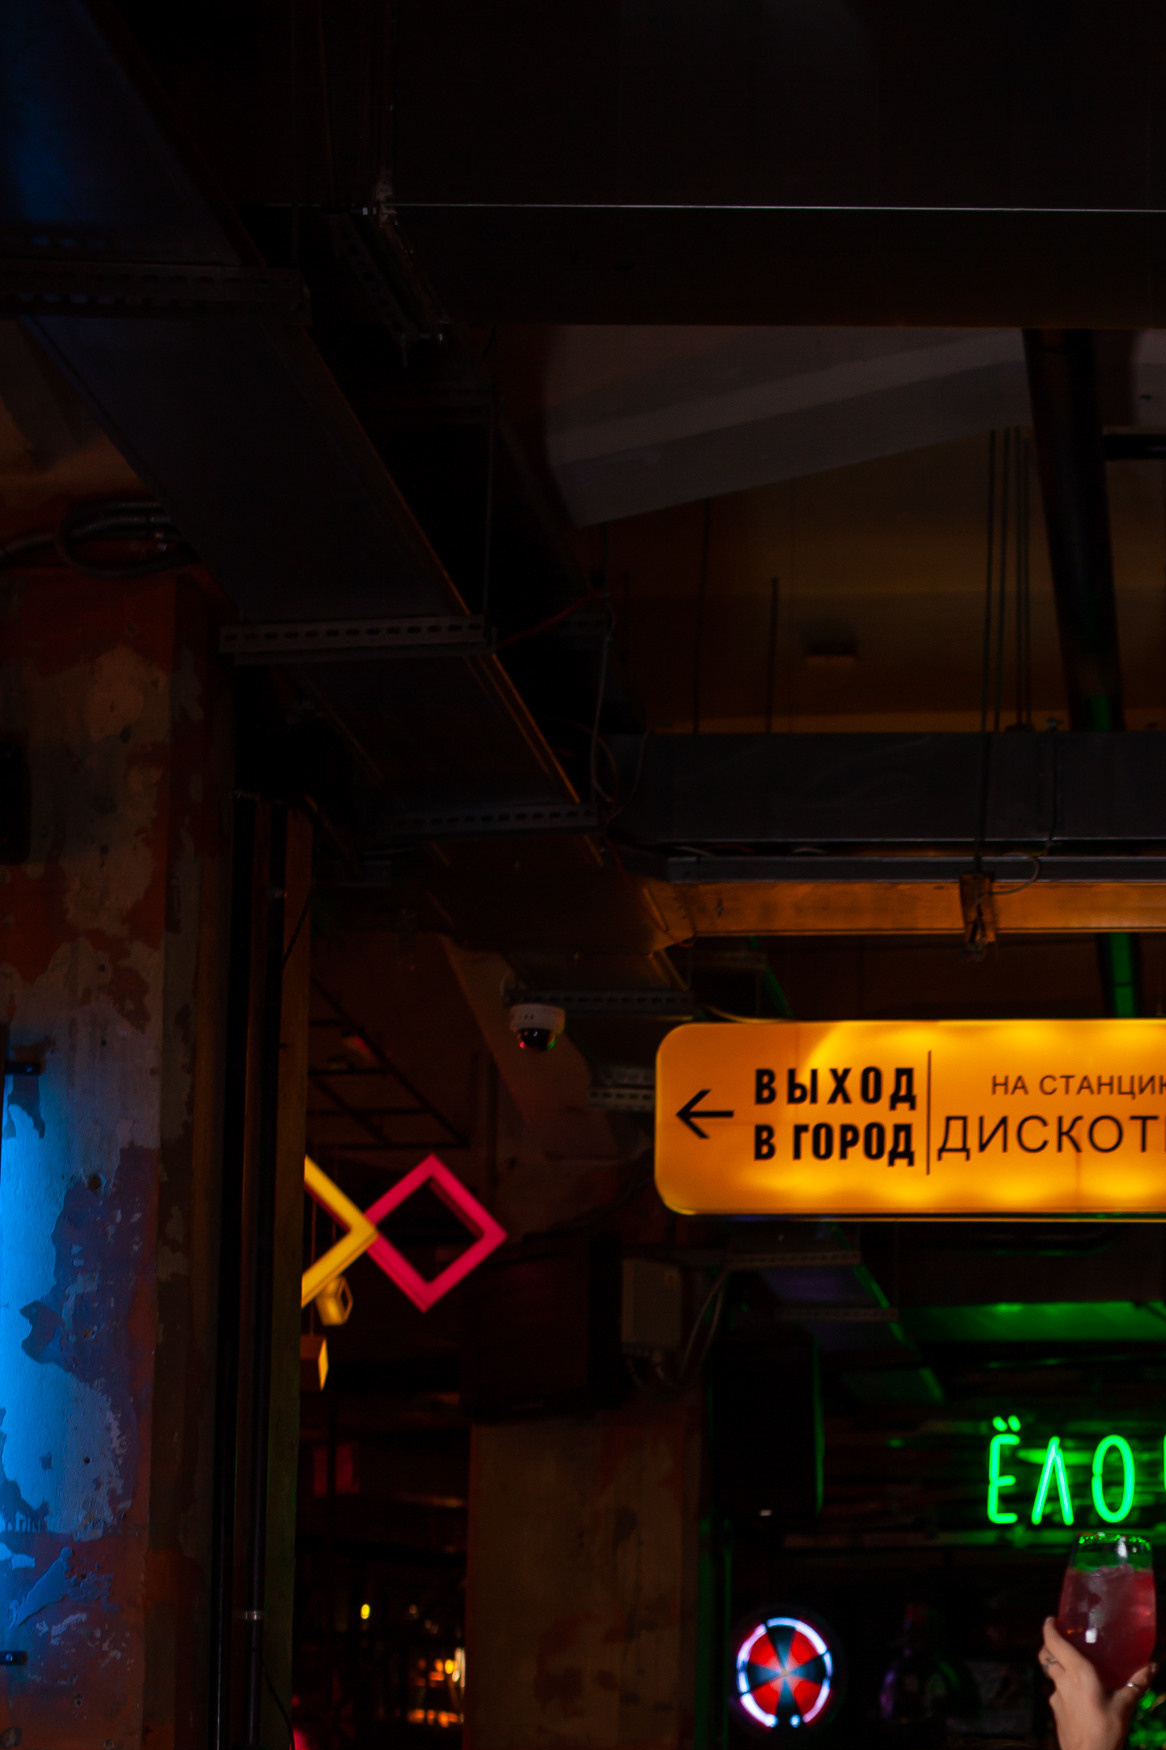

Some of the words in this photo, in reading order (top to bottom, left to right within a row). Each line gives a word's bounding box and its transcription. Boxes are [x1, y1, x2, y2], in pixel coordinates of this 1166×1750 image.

[753, 1066, 917, 1111] ВЫХОД
[990, 1074, 1030, 1096] НА
[753, 1122, 777, 1162] В
[792, 1122, 916, 1168] ГОРОД
